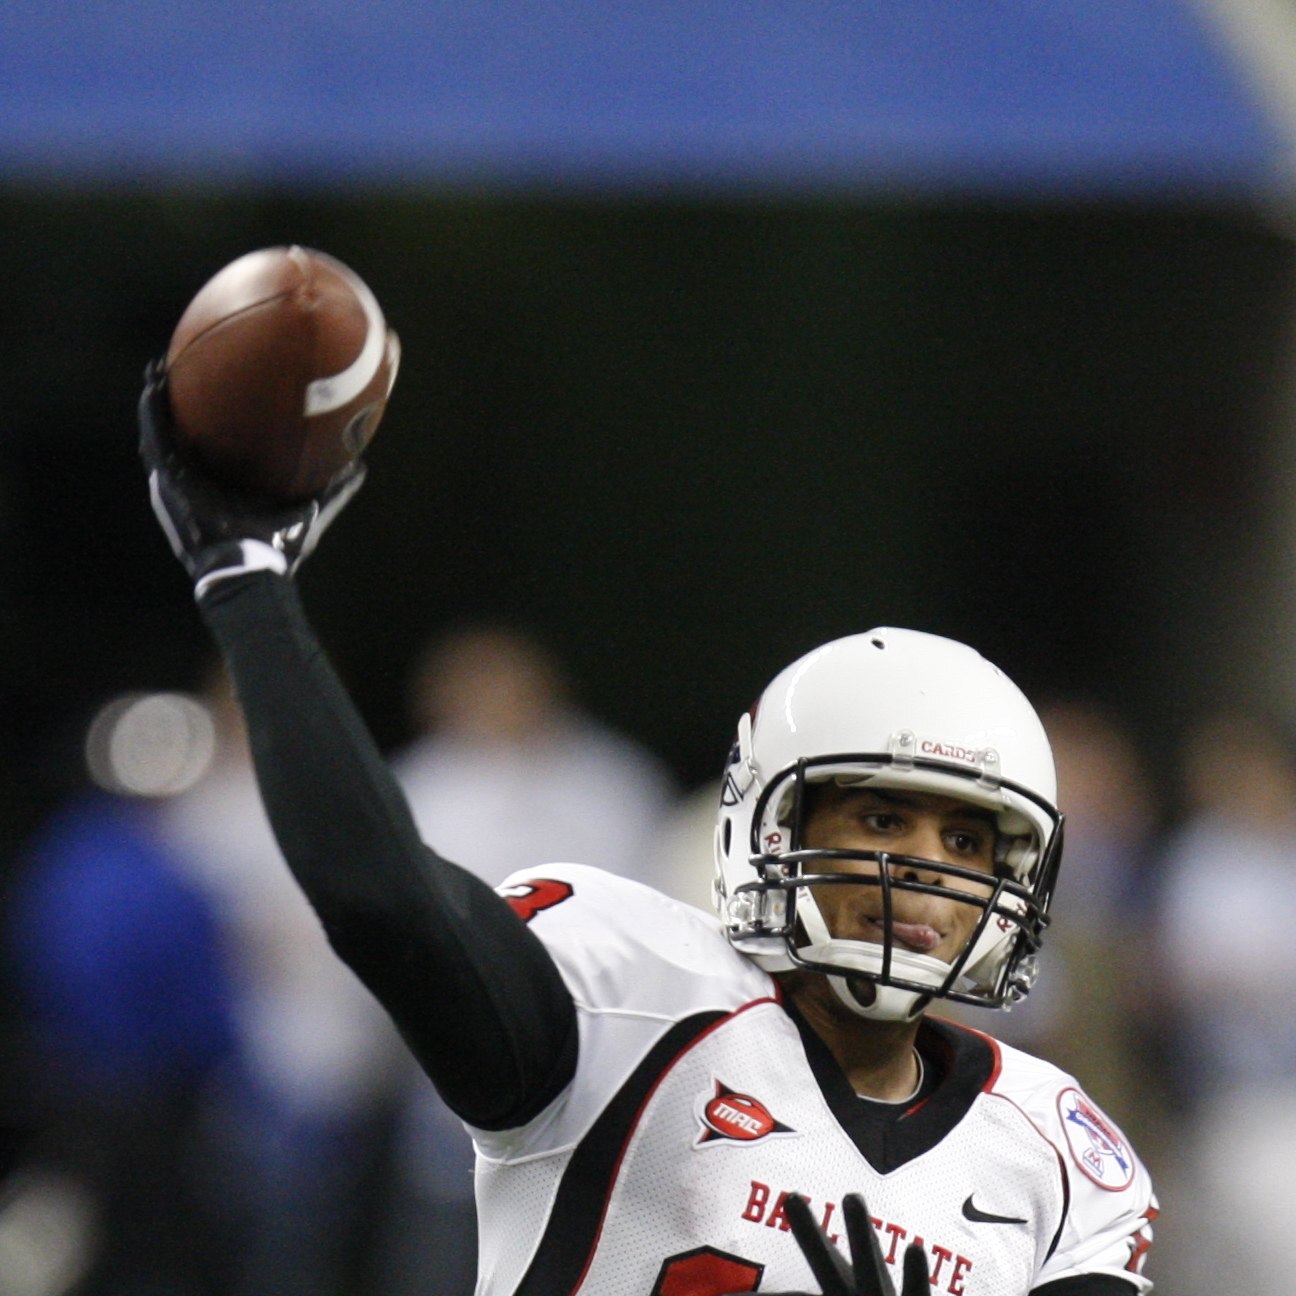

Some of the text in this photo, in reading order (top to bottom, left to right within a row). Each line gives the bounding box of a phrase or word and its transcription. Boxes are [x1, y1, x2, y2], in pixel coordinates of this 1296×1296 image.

[921, 740, 975, 762] CARDS
[712, 1102, 764, 1135] MAC
[741, 1180, 839, 1244] BAL
